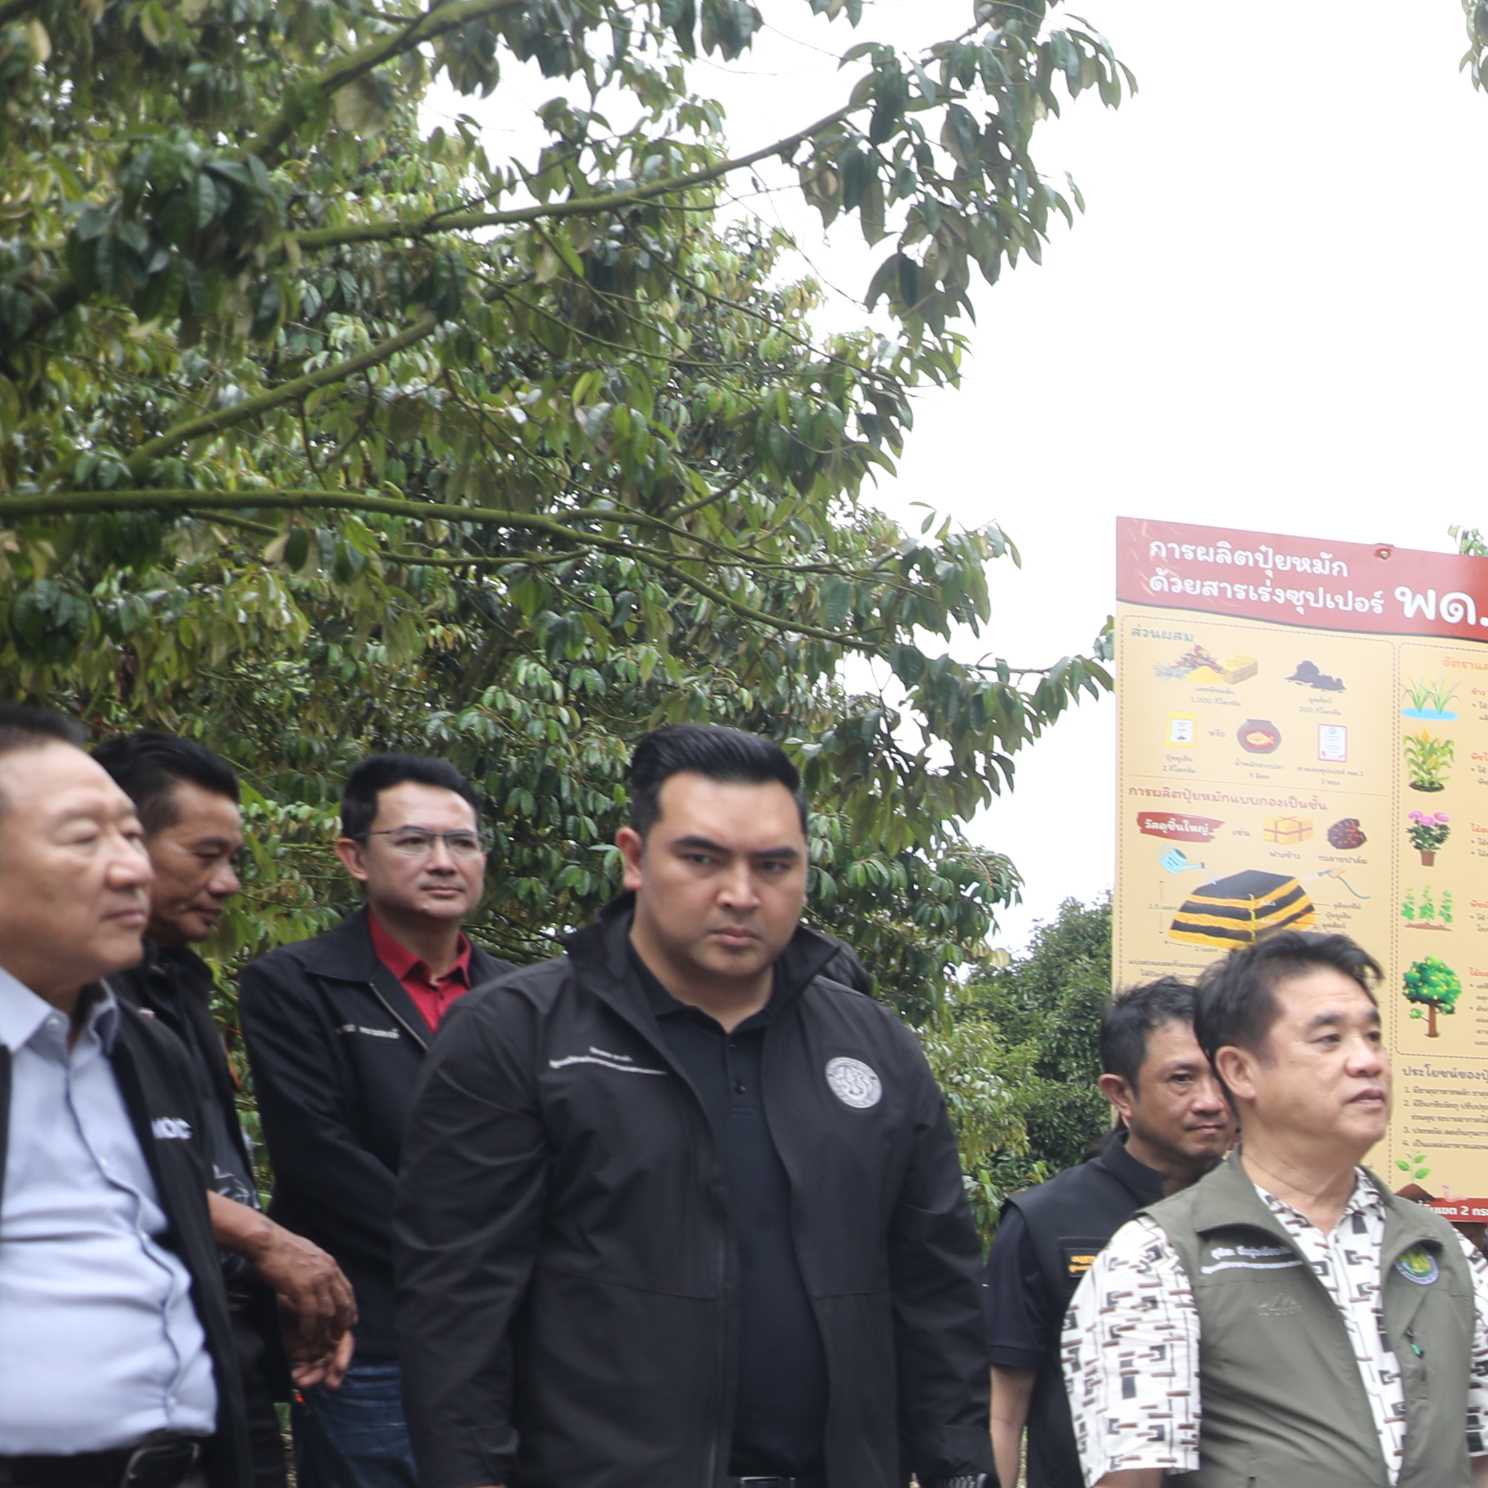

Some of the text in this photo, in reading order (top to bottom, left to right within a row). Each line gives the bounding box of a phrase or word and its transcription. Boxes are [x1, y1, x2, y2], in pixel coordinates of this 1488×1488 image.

[1149, 540, 1349, 578] การผลิตปุ๋ยหมัก
[1149, 568, 1385, 615] ด้วยสารเร่งซุปเปอร์
[1131, 624, 1195, 643] ส่วนผสม
[1460, 1205, 1470, 1216] 2
